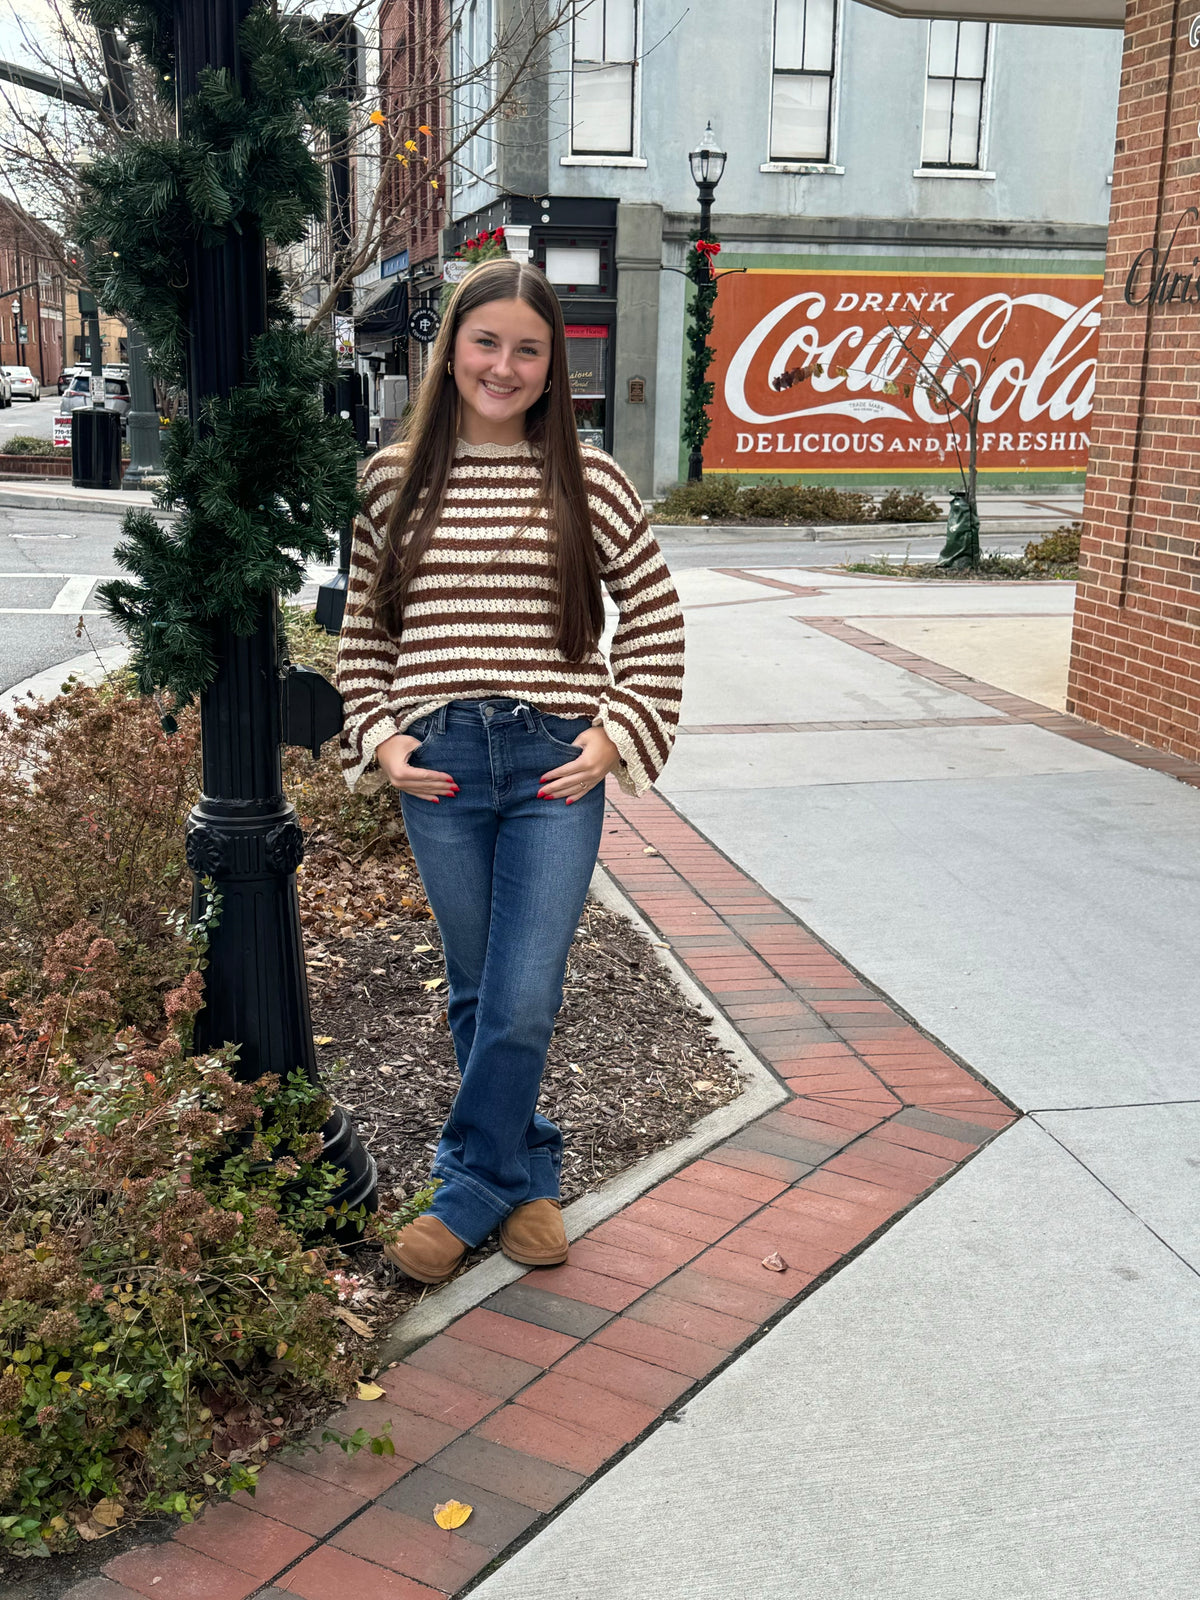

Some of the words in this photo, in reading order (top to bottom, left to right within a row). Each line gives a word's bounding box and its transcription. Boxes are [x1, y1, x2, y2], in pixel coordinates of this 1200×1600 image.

[833, 292, 955, 312] DRINK
[735, 433, 884, 453] DELICIOUS
[887, 437, 940, 452] AND
